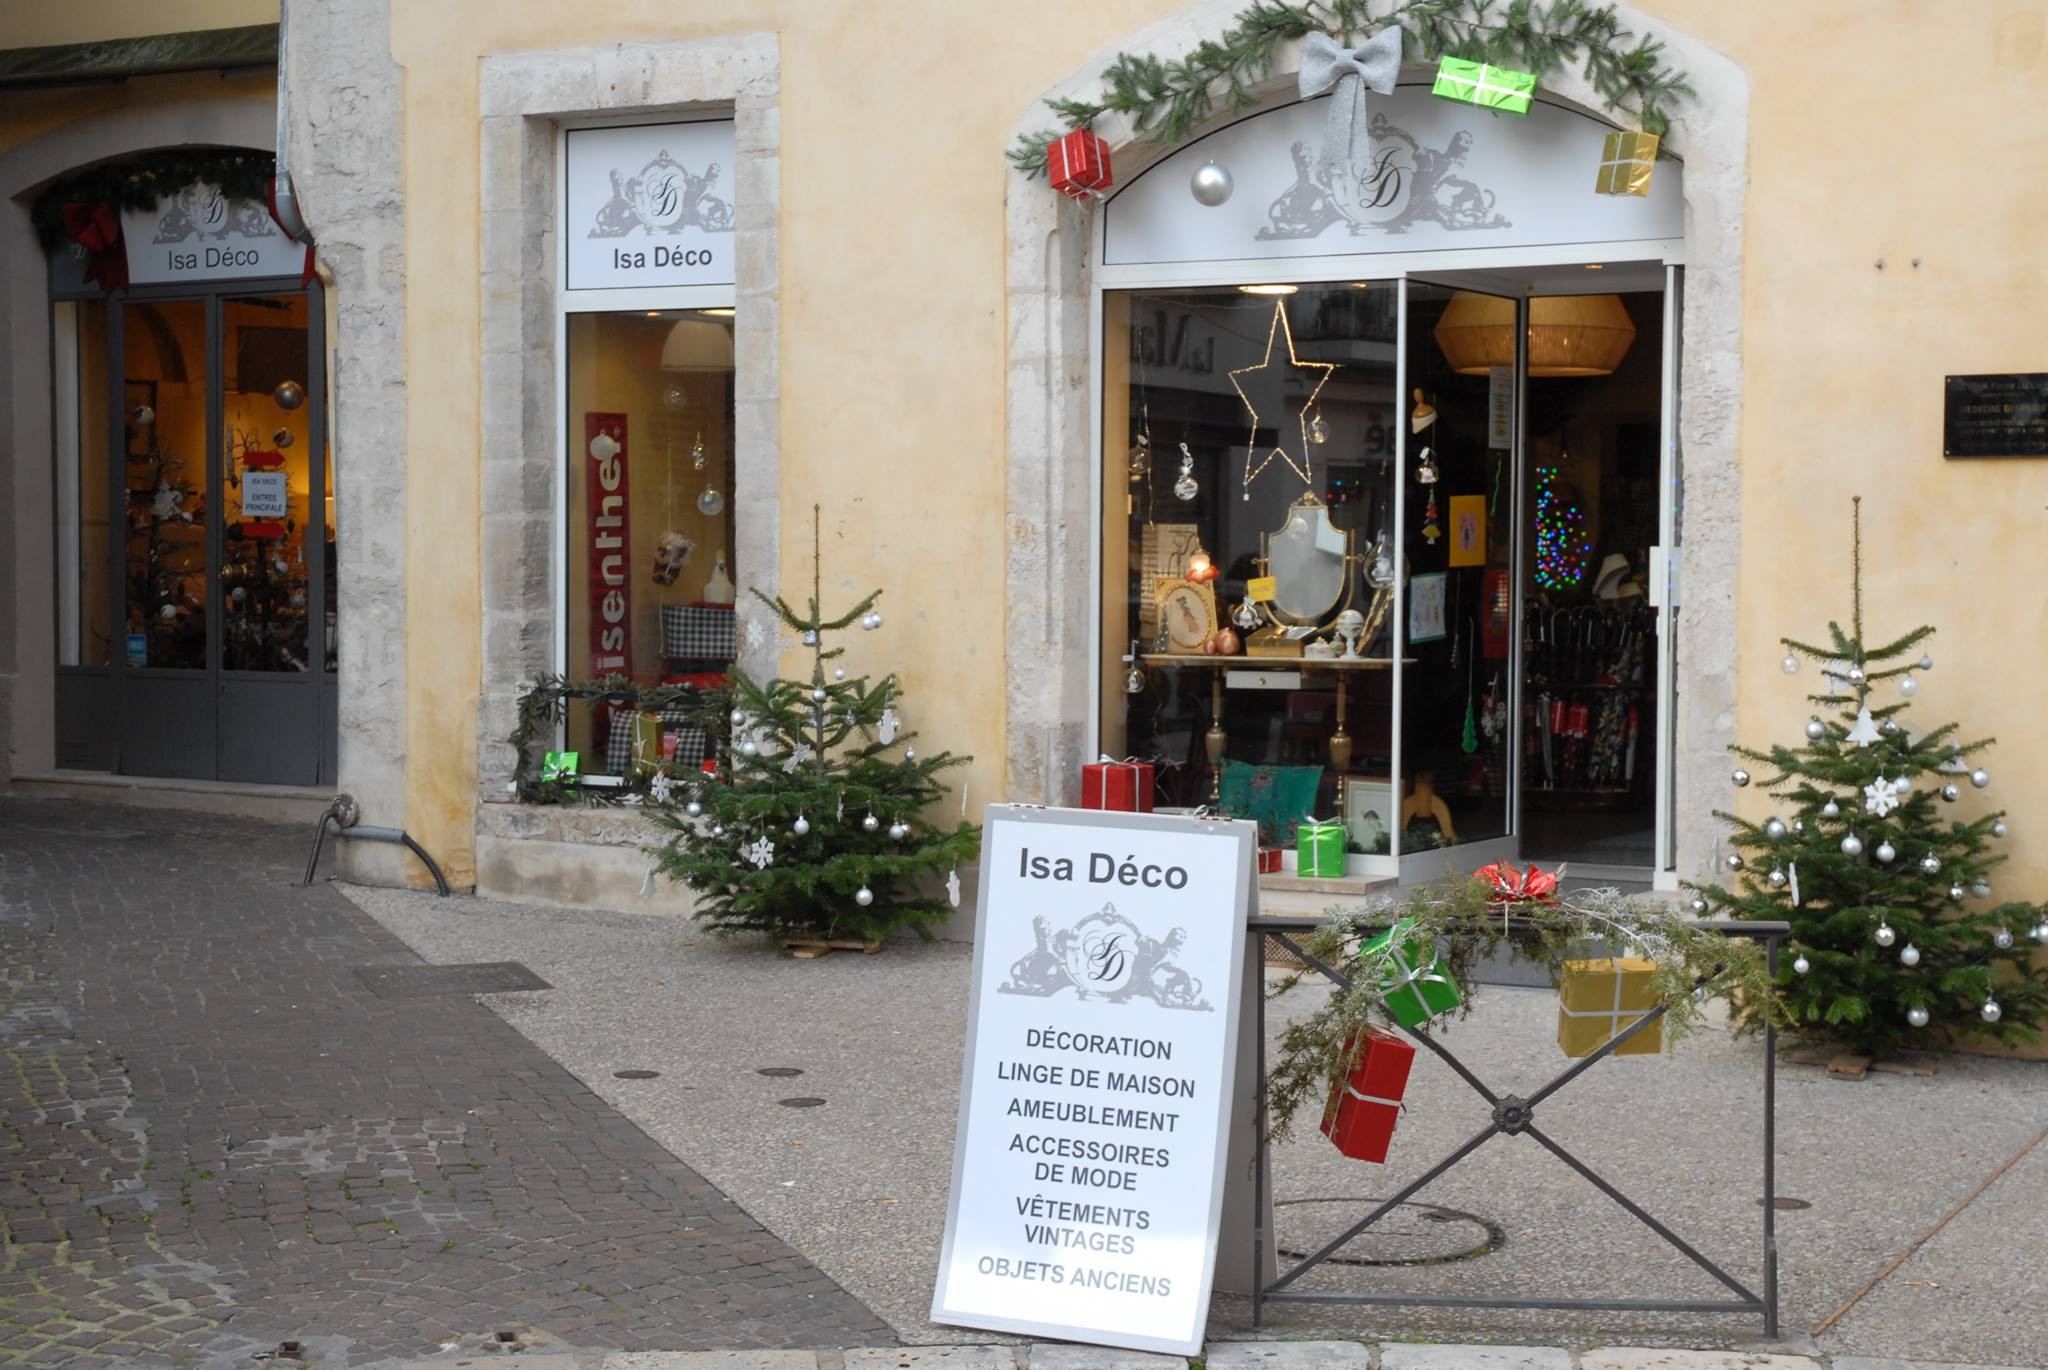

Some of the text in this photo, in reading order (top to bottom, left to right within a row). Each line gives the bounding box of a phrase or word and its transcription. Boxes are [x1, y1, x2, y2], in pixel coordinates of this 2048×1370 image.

[168, 246, 260, 270] Isa Déco
[614, 244, 712, 269] Isa Déco
[1020, 847, 1189, 890] Isa Déco
[1026, 1026, 1172, 1060] DÉCORATION
[997, 1060, 1196, 1099] LINGE DE MAISON
[1005, 1097, 1181, 1133] AMEUBLEMENT
[1008, 1133, 1171, 1169] ACCESSOIRES
[1034, 1161, 1138, 1193] DE MODE
[1015, 1193, 1150, 1231] VÊTEMENTS
[1024, 1223, 1135, 1255] VINTAGES
[978, 1255, 1171, 1297] OBJETS ANCIENS
